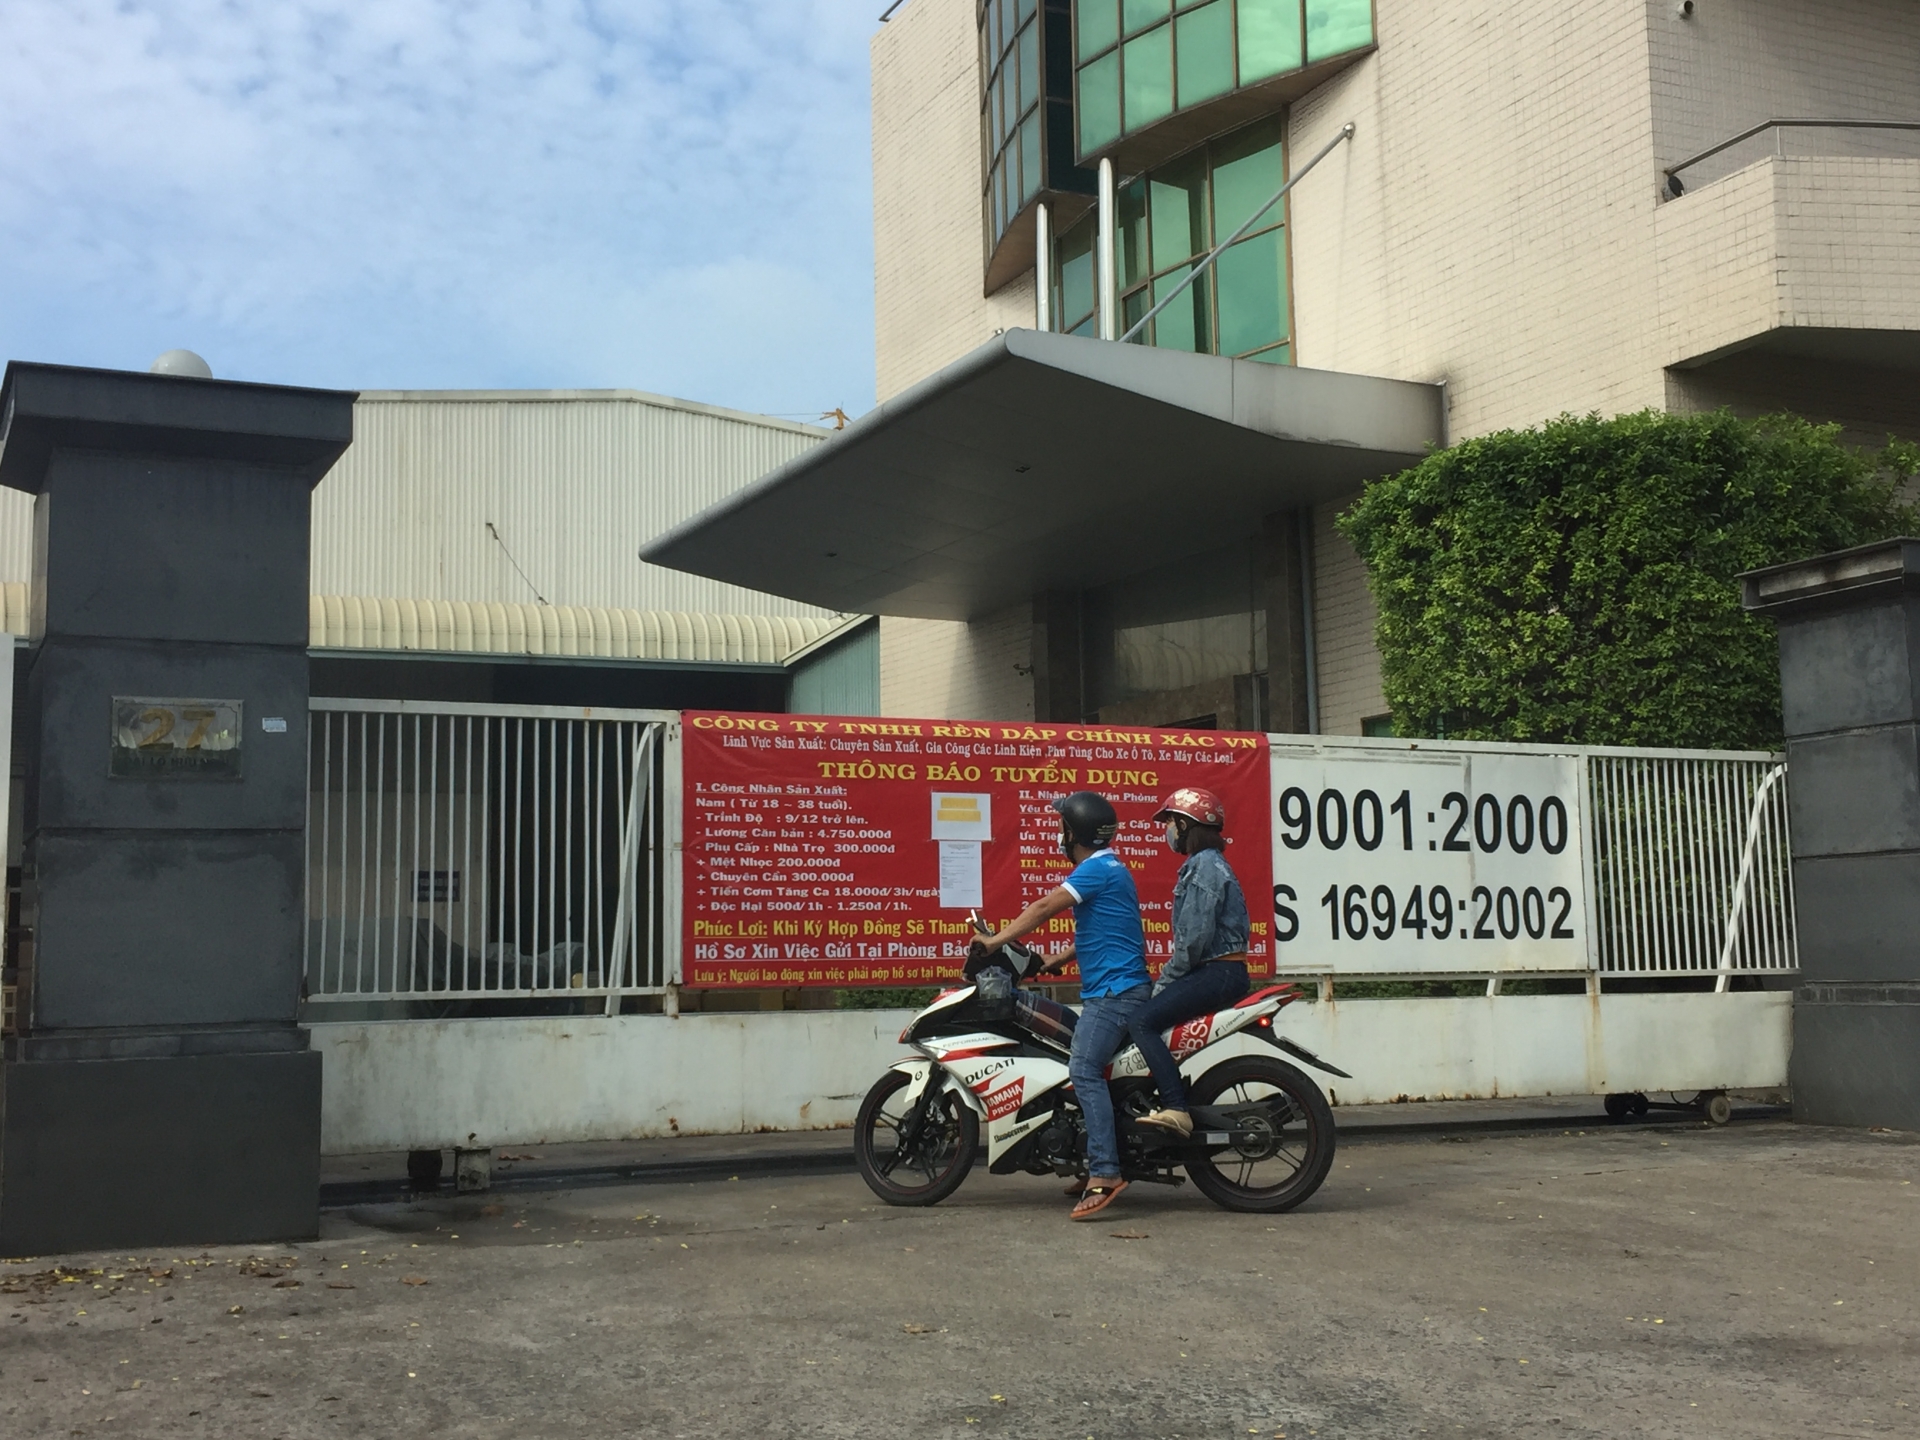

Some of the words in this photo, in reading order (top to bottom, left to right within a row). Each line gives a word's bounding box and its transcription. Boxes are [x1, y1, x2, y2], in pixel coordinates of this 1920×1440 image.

[139, 708, 216, 751] 27
[693, 715, 780, 731] CÔNG
[790, 721, 829, 733] TY
[839, 723, 923, 736] TNHH
[932, 723, 991, 739] RÈN
[1001, 727, 1057, 743] DẬP
[1066, 729, 1153, 744] CHÍNH
[1160, 733, 1216, 747] XÁC
[1222, 737, 1257, 749] VN
[751, 736, 771, 750] Vực
[775, 735, 795, 749] Sản
[798, 735, 826, 750] Xuất:
[830, 738, 870, 754] Chuyên
[873, 739, 892, 752] Sản
[895, 739, 922, 754] Xuất,
[926, 741, 942, 754] Gia
[945, 742, 970, 757] Công
[973, 743, 991, 755] Các
[994, 744, 1016, 756] Linh
[1019, 745, 1042, 758] Kiện
[1069, 746, 1093, 761] Tùng
[1095, 747, 1113, 759] Cho
[1116, 748, 1129, 760] Xe
[1158, 750, 1171, 761] Xe
[1174, 751, 1192, 764] Máy
[1195, 752, 1212, 763] Các
[817, 759, 917, 780] THÔNG
[926, 762, 981, 781] BÁO
[990, 760, 1077, 784] TUYỂN
[1087, 769, 1159, 788] DỤNG
[696, 783, 706, 792] I.
[711, 783, 744, 793] Công
[749, 784, 782, 793] Nhân
[786, 783, 810, 794] Sản
[814, 785, 847, 795] Xuất:
[1019, 790, 1034, 799] II.
[1124, 792, 1158, 803] Phòng
[696, 798, 725, 808] Nam
[763, 799, 779, 808] 18
[797, 800, 814, 809] 38
[1020, 804, 1040, 813] Yêu
[745, 813, 763, 825] Độ
[822, 815, 841, 824] trở
[1021, 818, 1030, 827] 1.
[1129, 820, 1151, 830] Cấp
[1279, 786, 1568, 854] 9001:2000
[705, 828, 747, 838] Lương
[752, 829, 776, 838] Căn
[781, 829, 804, 838] bản
[817, 829, 891, 839] 4.750.000đ
[1116, 833, 1141, 843] Auto
[1145, 834, 1166, 843] Cad
[705, 843, 730, 854] Phụ
[735, 841, 760, 853] Cấp
[773, 843, 798, 853] Nhà
[803, 844, 825, 856] Trọ
[834, 843, 895, 854] 300.000đ
[1020, 845, 1045, 855] Mức
[1123, 846, 1157, 858] Thuận
[710, 857, 735, 868] Mệt
[740, 857, 773, 868] Nhọc
[777, 857, 840, 868] 200.000đ
[1045, 859, 1074, 868] Nhân
[710, 872, 758, 883] Chuyên
[763, 870, 787, 882] Cần
[791, 872, 854, 882] 300.000đ
[1021, 873, 1042, 882] Yêu
[711, 885, 739, 896] Tiền
[743, 886, 772, 896] Cơm
[777, 886, 808, 898] Tăng
[813, 887, 830, 897] Ca
[711, 902, 735, 914] Độc
[741, 902, 761, 914] Hại
[1322, 883, 1573, 940] 16949:2002
[694, 919, 732, 936] Phúc
[773, 920, 798, 936] Khi
[804, 919, 822, 938] Ký
[828, 919, 858, 940] Hợp
[863, 920, 901, 937] Đồng
[907, 919, 924, 935] Sẽ
[929, 919, 968, 934] Tham
[1050, 918, 1077, 933] BHY
[1142, 918, 1170, 933] Theo
[695, 941, 717, 958] Hồ
[724, 943, 747, 958] Sơ
[752, 944, 778, 958] Xin
[784, 942, 817, 960] Việc
[825, 940, 851, 958] Gửi
[857, 942, 879, 960] Tại
[888, 942, 937, 959] Phòng
[1146, 939, 1162, 954] Và
[695, 968, 713, 980] Lưu
[762, 967, 777, 981] lao
[780, 967, 804, 983] động
[808, 967, 822, 980] xin
[848, 965, 868, 982] phải
[965, 1058, 1015, 1085] DUCATI
[987, 1084, 1023, 1107] YAMAHA
